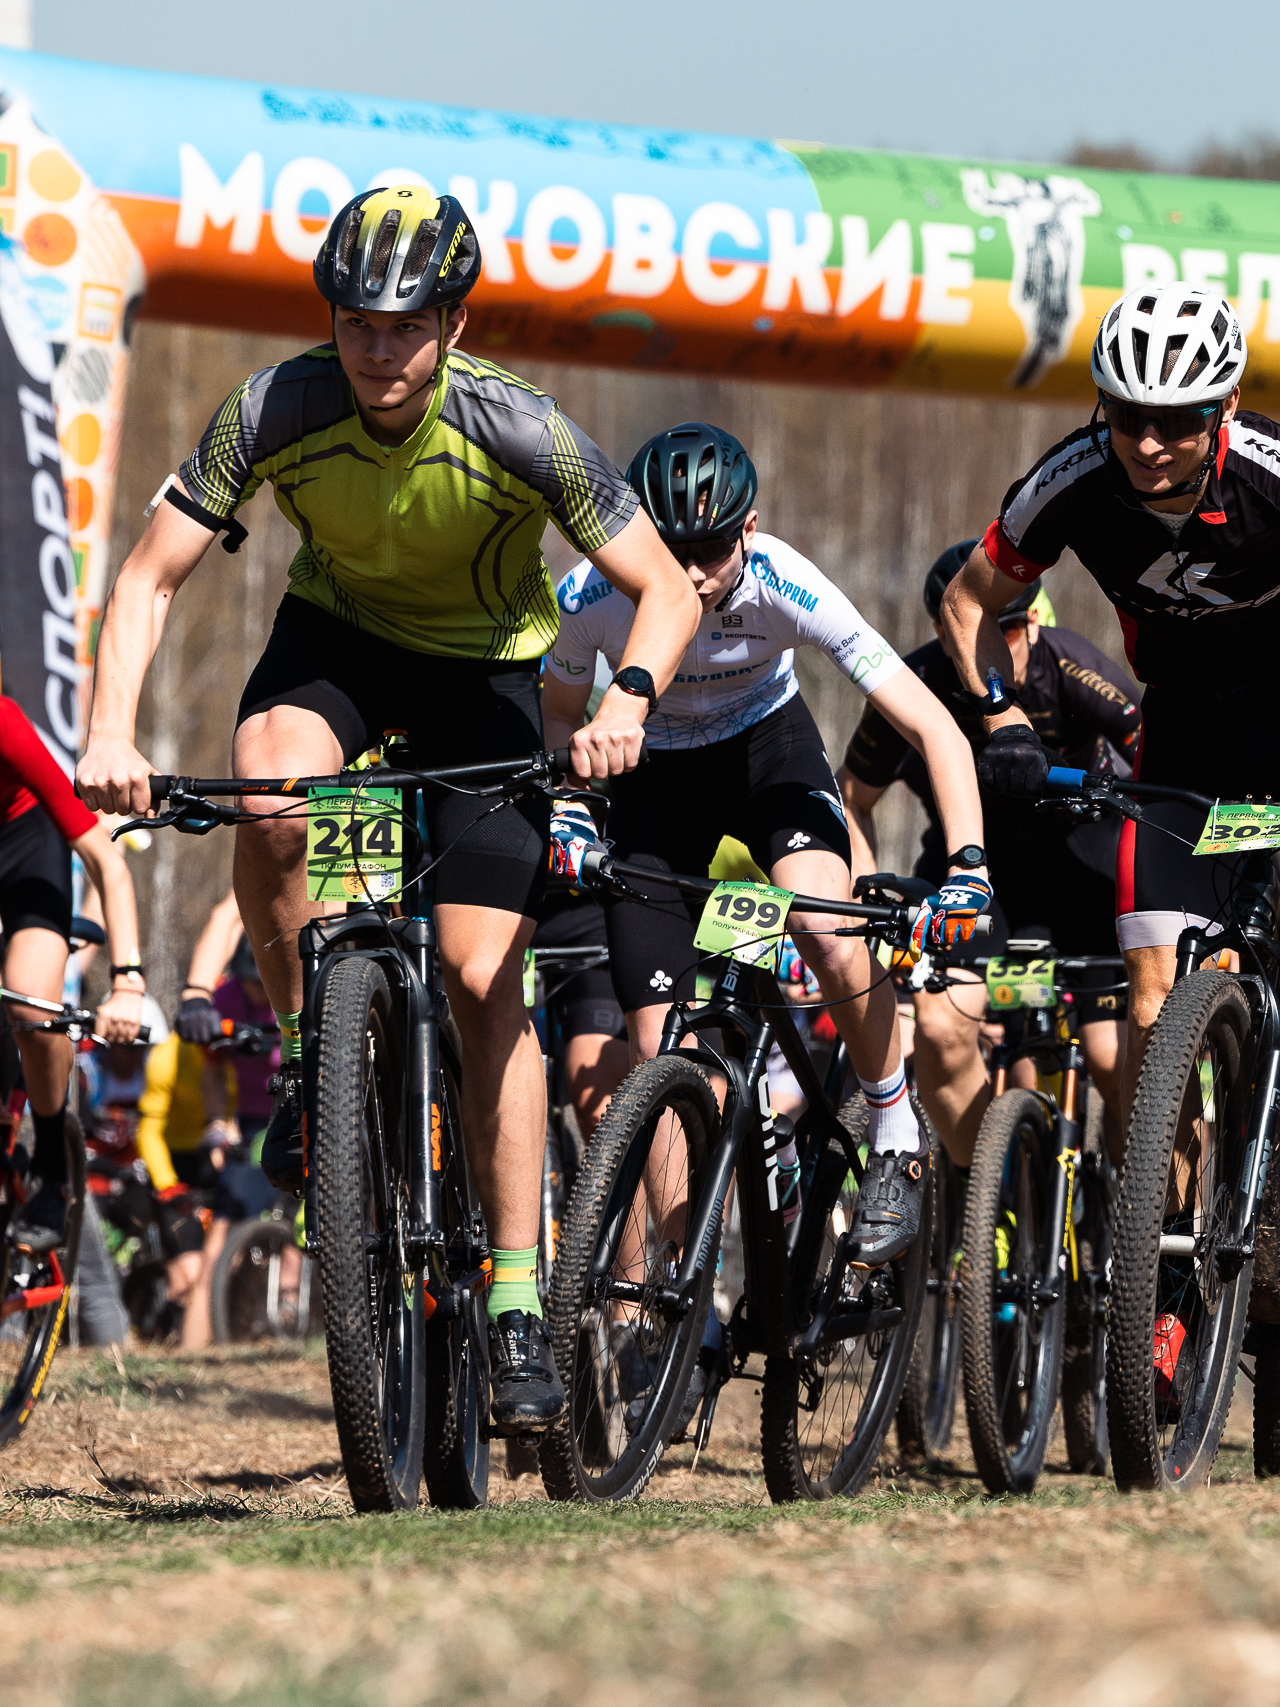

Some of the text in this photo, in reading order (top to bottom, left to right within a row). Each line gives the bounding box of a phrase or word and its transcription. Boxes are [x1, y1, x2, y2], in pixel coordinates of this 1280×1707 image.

[176, 143, 977, 326] МОКОВСКИЕ
[831, 631, 860, 655] Ak Bars
[835, 647, 857, 663] Bank
[313, 818, 395, 855] 214
[714, 894, 781, 929] 199
